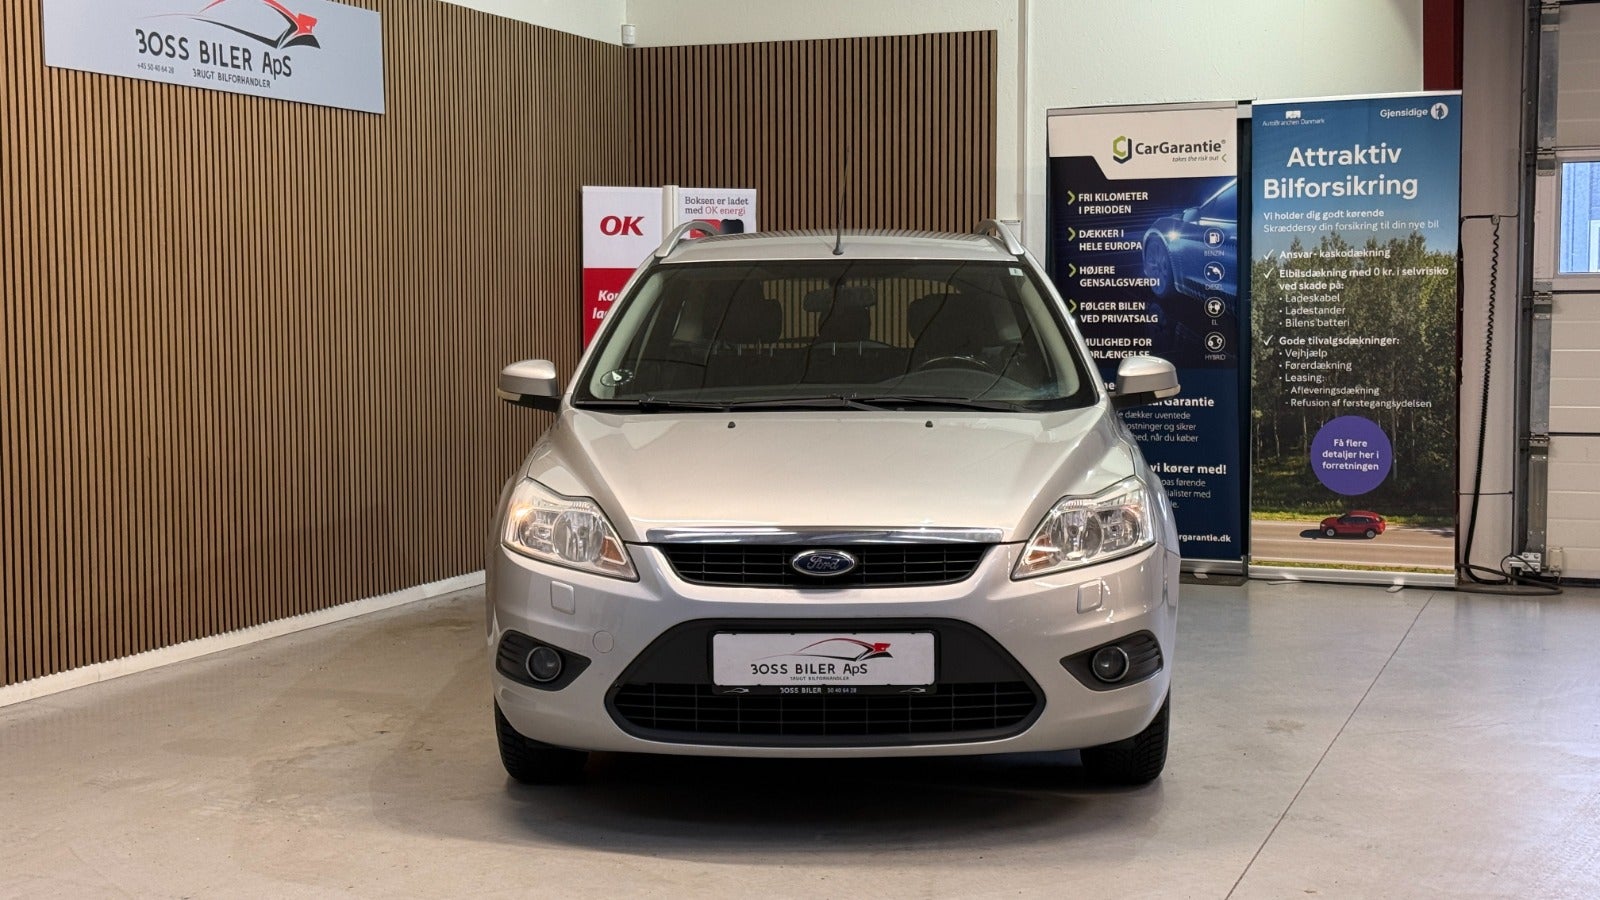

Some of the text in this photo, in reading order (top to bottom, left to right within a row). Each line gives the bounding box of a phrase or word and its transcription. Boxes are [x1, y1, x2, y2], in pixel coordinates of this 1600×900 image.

[199, 40, 253, 71] BILER
[262, 51, 292, 80] ApS
[217, 71, 271, 88] BILFORHANDLER
[1379, 108, 1429, 119] Gjensidige
[1286, 142, 1402, 168] Attraktiv
[1263, 173, 1418, 200] Bilforsikring
[685, 196, 715, 205] Boksen
[727, 196, 749, 205] ladet
[1078, 192, 1149, 202] FRI KILOMETER
[685, 206, 746, 217] med OK energi
[1078, 205, 1132, 214] I PERIODEN
[1263, 209, 1384, 221] Vi holder dig godt kørende
[600, 215, 645, 236] OK
[1263, 220, 1439, 234] Skræddersy din forsikring til din nye bil
[1079, 229, 1124, 239] DÆKKER I
[1079, 241, 1143, 251] HELE EUROPA
[1319, 249, 1391, 259] kaskodækning
[1079, 265, 1116, 275] HØJERE
[1279, 266, 1449, 279] Elbilsdækning med 0 kr. i selvrisiko
[1079, 278, 1160, 287] GENSALGSVÆRDI
[1279, 281, 1344, 292] ved skade på:
[1285, 294, 1340, 302] Ladeskabel
[1080, 302, 1146, 311] FØLGER BILEN
[1285, 306, 1346, 315] Ladestander
[1080, 314, 1159, 323] VED PRIVATSALG
[1285, 318, 1350, 327] Bilens batteri
[1133, 338, 1152, 347] FOR
[1279, 336, 1400, 347] Gode tilvalgsdækninger:
[1285, 349, 1328, 359] Vejhjælp
[1285, 361, 1352, 371] Førerdækning
[1285, 373, 1325, 383] Leasing:
[1290, 386, 1380, 396] Afleveringsdækning
[1290, 398, 1330, 407] Refusion
[1331, 398, 1341, 407] af
[1124, 410, 1153, 419] dækker
[1154, 411, 1191, 420] uventede
[1127, 422, 1197, 432] ostninger og sikrer
[1150, 433, 1163, 442] når
[1164, 433, 1175, 441] du
[1176, 433, 1199, 442] køber
[1333, 438, 1368, 447] Få flere
[1322, 450, 1380, 460] detaljer her i
[1163, 462, 1195, 473] kører
[1197, 464, 1227, 475] med!
[1322, 461, 1379, 472] forretningen
[1176, 478, 1206, 487] førende
[1193, 490, 1211, 498] med
[1178, 534, 1232, 543] rgarantie.dk
[806, 555, 840, 570] Ford
[795, 663, 836, 675] BILER
[843, 663, 868, 677] ApS
